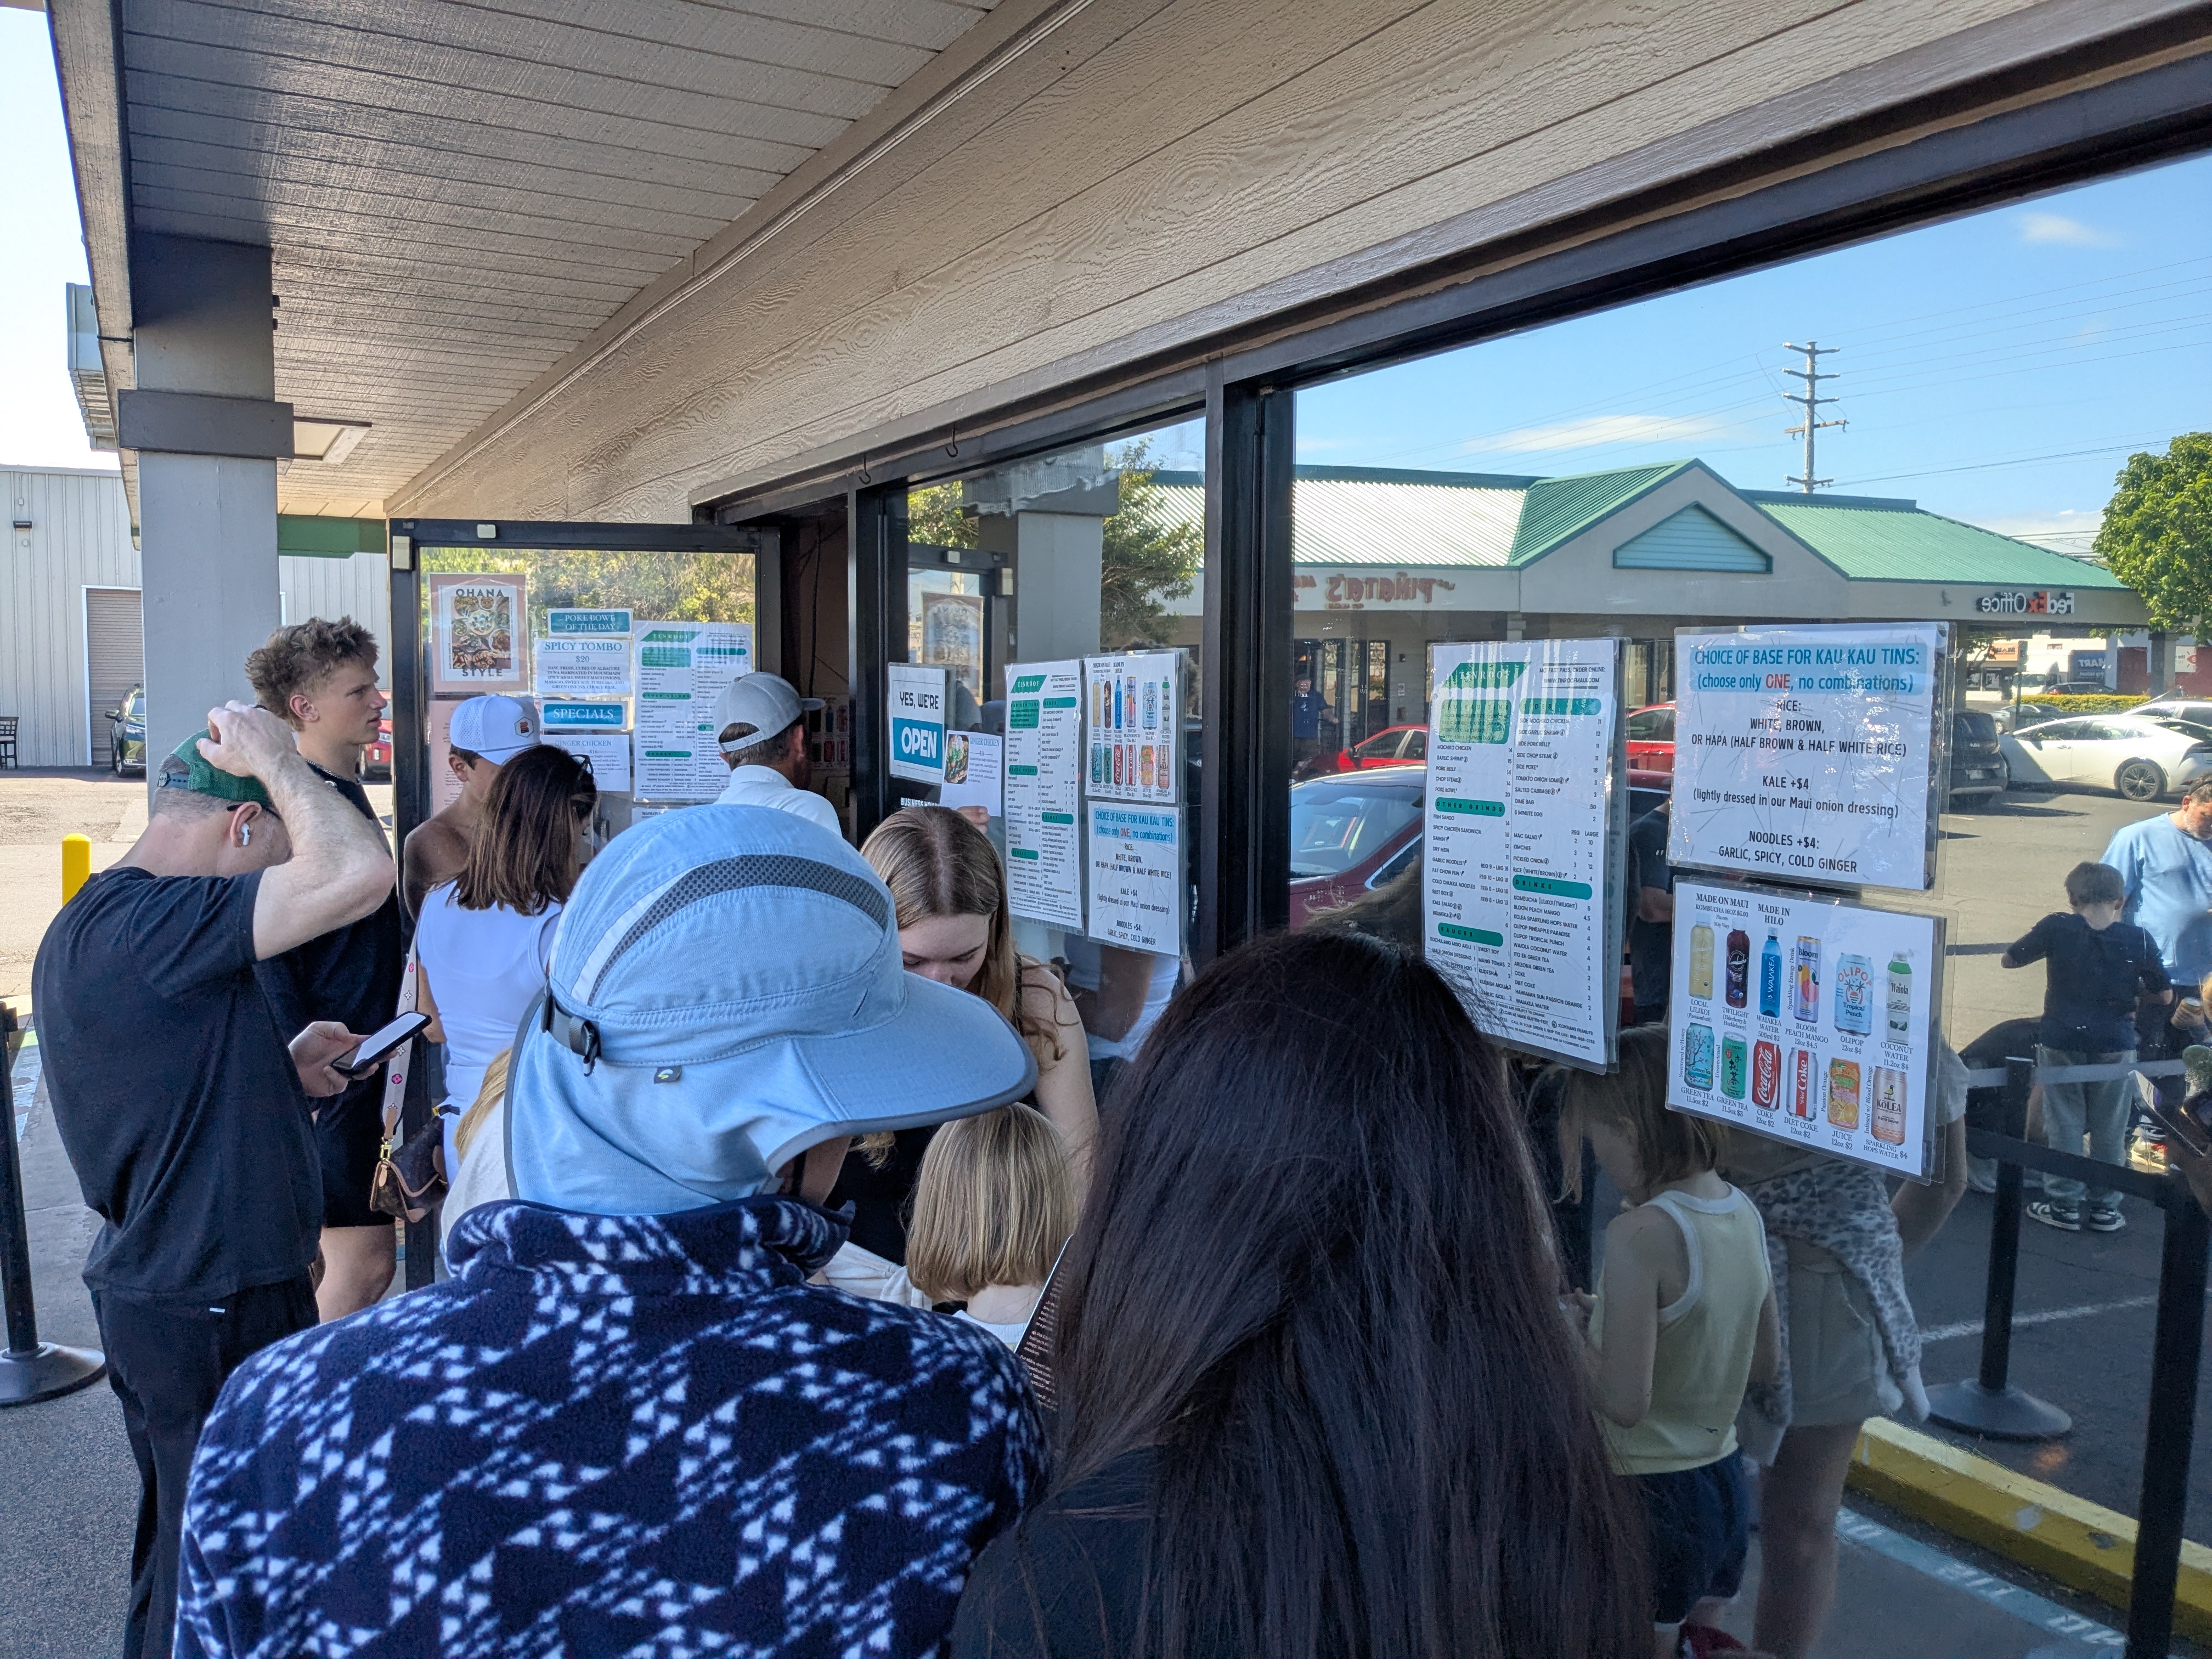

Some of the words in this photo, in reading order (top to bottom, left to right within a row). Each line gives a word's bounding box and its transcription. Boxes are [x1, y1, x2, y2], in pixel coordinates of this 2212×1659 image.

[456, 589, 504, 597] OHANA
[545, 642, 576, 652] SPICY
[579, 642, 622, 651] TOMBO
[1695, 650, 1733, 665] CHOICE
[1736, 650, 1750, 665] OF
[1753, 650, 1783, 665] BASE
[1787, 649, 1811, 664] FOR
[1815, 649, 1842, 664] KAU
[1847, 649, 1876, 664] KAU
[1881, 648, 1919, 665] TINS:
[462, 668, 503, 677] STYLE
[1459, 670, 1511, 680] TINROOF
[1697, 674, 1736, 690] (choose
[1739, 674, 1761, 691] only
[1765, 674, 1794, 691] ONE,
[1798, 677, 1813, 689] no
[900, 691, 916, 709] YES,
[918, 693, 939, 710] WE'RE
[1776, 700, 1801, 712] RICE:
[554, 708, 614, 719] SPECIALS
[1750, 718, 1782, 732] WHITE,
[1786, 719, 1824, 733] BROWN,
[901, 726, 937, 759] OPEN
[1691, 734, 1702, 745] OR
[1705, 735, 1727, 747] HAPA
[1730, 735, 1756, 749] (HALF
[1759, 738, 1793, 750] BROWN
[1797, 740, 1804, 751] &
[1808, 740, 1835, 752] HALF
[1839, 741, 1872, 754] WHITE
[1876, 743, 1906, 757] RICE)
[1763, 776, 1786, 788] KALE
[1790, 776, 1809, 791] +$4
[901, 797, 923, 806] BUSINESS
[1693, 788, 1721, 804] (lightly
[1723, 792, 1755, 805] dressed
[1759, 795, 1769, 806] in
[1770, 798, 1786, 808] our
[1790, 797, 1812, 809] Maui
[1815, 801, 1843, 812] onion
[1847, 802, 1898, 819] dressing)
[1096, 811, 1109, 821] CHOICE
[1110, 812, 1115, 821] OF
[1116, 812, 1127, 822] BASE
[1128, 814, 1137, 823] FOR
[1138, 815, 1148, 825] KAU
[1150, 816, 1160, 826] KAU
[1161, 817, 1174, 827] TINS:
[1097, 826, 1111, 835] (choose
[1140, 831, 1173, 843] combinations)
[1749, 831, 1793, 846] NOODLES
[1797, 837, 1819, 850] +$4:
[1719, 845, 1751, 862] GARLIC,
[1754, 849, 1785, 867] SPICY,
[1788, 855, 1814, 868] COLD
[1818, 858, 1857, 873] GINGER
[1516, 879, 1551, 889] DRINKS
[1696, 893, 1717, 903] MADE
[1718, 896, 1729, 905] ON
[1730, 898, 1748, 908] MAUI
[1695, 904, 1724, 913] KOMBUCHA
[1758, 904, 1780, 915] MADE
[1782, 907, 1790, 916] IN
[1764, 915, 1784, 926] HILO
[1441, 927, 1472, 936] SAUCES
[1798, 947, 1818, 958] Bloom
[1838, 967, 1872, 986] OLIPOP
[1891, 983, 1909, 995] Waiola
[1691, 998, 1708, 1007] LOCAL
[1843, 1002, 1865, 1012] Tropical
[1690, 1007, 1710, 1015] LILIKOI
[1723, 1007, 1749, 1019] TWILIGHT
[1846, 1009, 1862, 1018] Punch
[1757, 1015, 1781, 1026] WAIAKEA
[1759, 1023, 1779, 1034] WATER
[1796, 1023, 1817, 1033] BLOOM
[1758, 1031, 1773, 1040] 500ml
[1785, 1028, 1804, 1038] PEACH
[1805, 1034, 1828, 1043] MANGO
[1841, 1036, 1864, 1046] OLIPOP
[1795, 1039, 1805, 1047] 12oz
[1881, 1042, 1913, 1054] COCONUT
[1842, 1045, 1853, 1053] 12oz
[1884, 1051, 1909, 1062] WATER
[1883, 1059, 1900, 1068] 11.2oz
[1901, 1062, 1909, 1070] $4
[1798, 1059, 1808, 1090] Coke
[1681, 1087, 1701, 1097] GREEN
[1702, 1092, 1714, 1101] TEA
[1702, 1099, 1708, 1107] $2
[1717, 1097, 1738, 1107] GREEN
[1737, 1102, 1748, 1111] TEA
[1757, 1109, 1773, 1119] COKE
[1756, 1116, 1767, 1126] 12oz
[1768, 1119, 1774, 1127] $2
[1784, 1116, 1798, 1127] DIET
[1800, 1121, 1818, 1132] COKE
[1832, 1131, 1852, 1142] JUICE
[1832, 1138, 1844, 1148] 12oz
[1866, 1139, 1897, 1152] SPARKLING
[1864, 1145, 1878, 1154] HOPS
[1879, 1147, 1899, 1159] WATER
